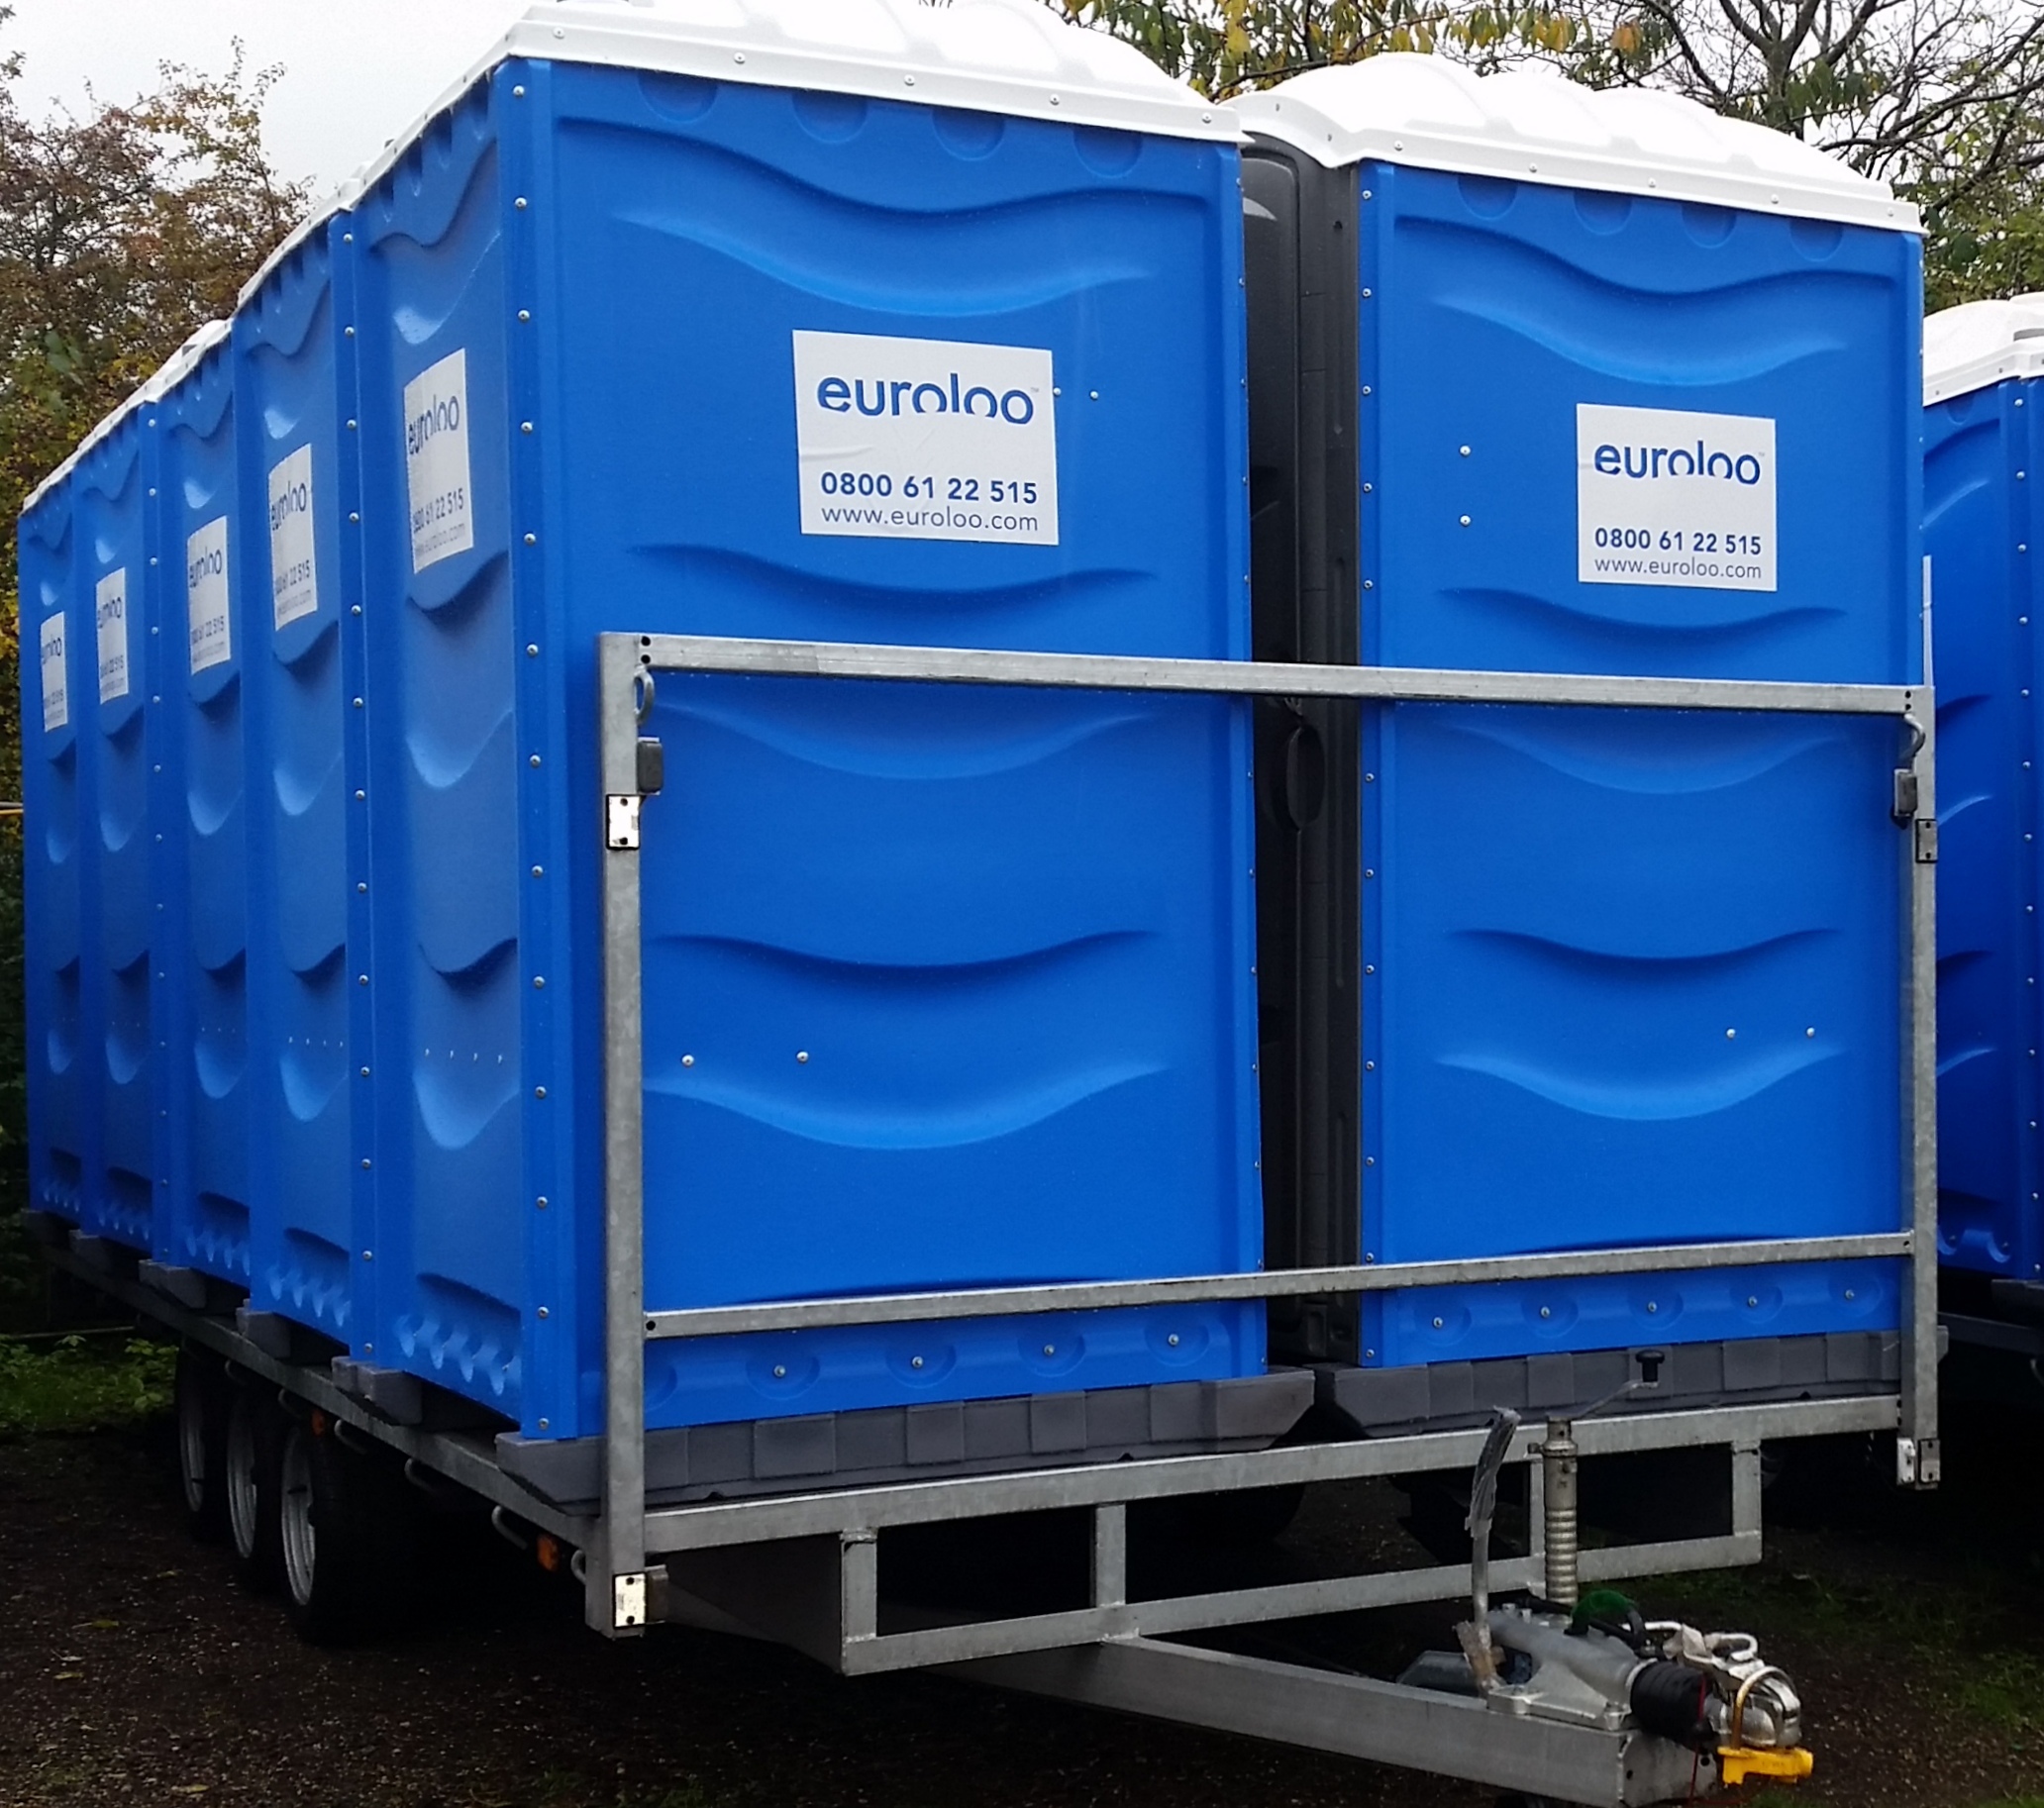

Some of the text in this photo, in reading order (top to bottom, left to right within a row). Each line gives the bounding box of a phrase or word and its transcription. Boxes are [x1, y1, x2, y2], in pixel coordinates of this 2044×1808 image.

[817, 372, 1034, 425] euroloo
[1594, 441, 1761, 485] euroloo
[821, 471, 1037, 504] 0800 61 22 515
[436, 496, 445, 521] 22
[448, 488, 463, 515] 515
[821, 505, 1038, 532] www.euroloo.com
[1594, 528, 1762, 555] 0800 61 22 515
[1594, 556, 1762, 579] www.euroloo.com
